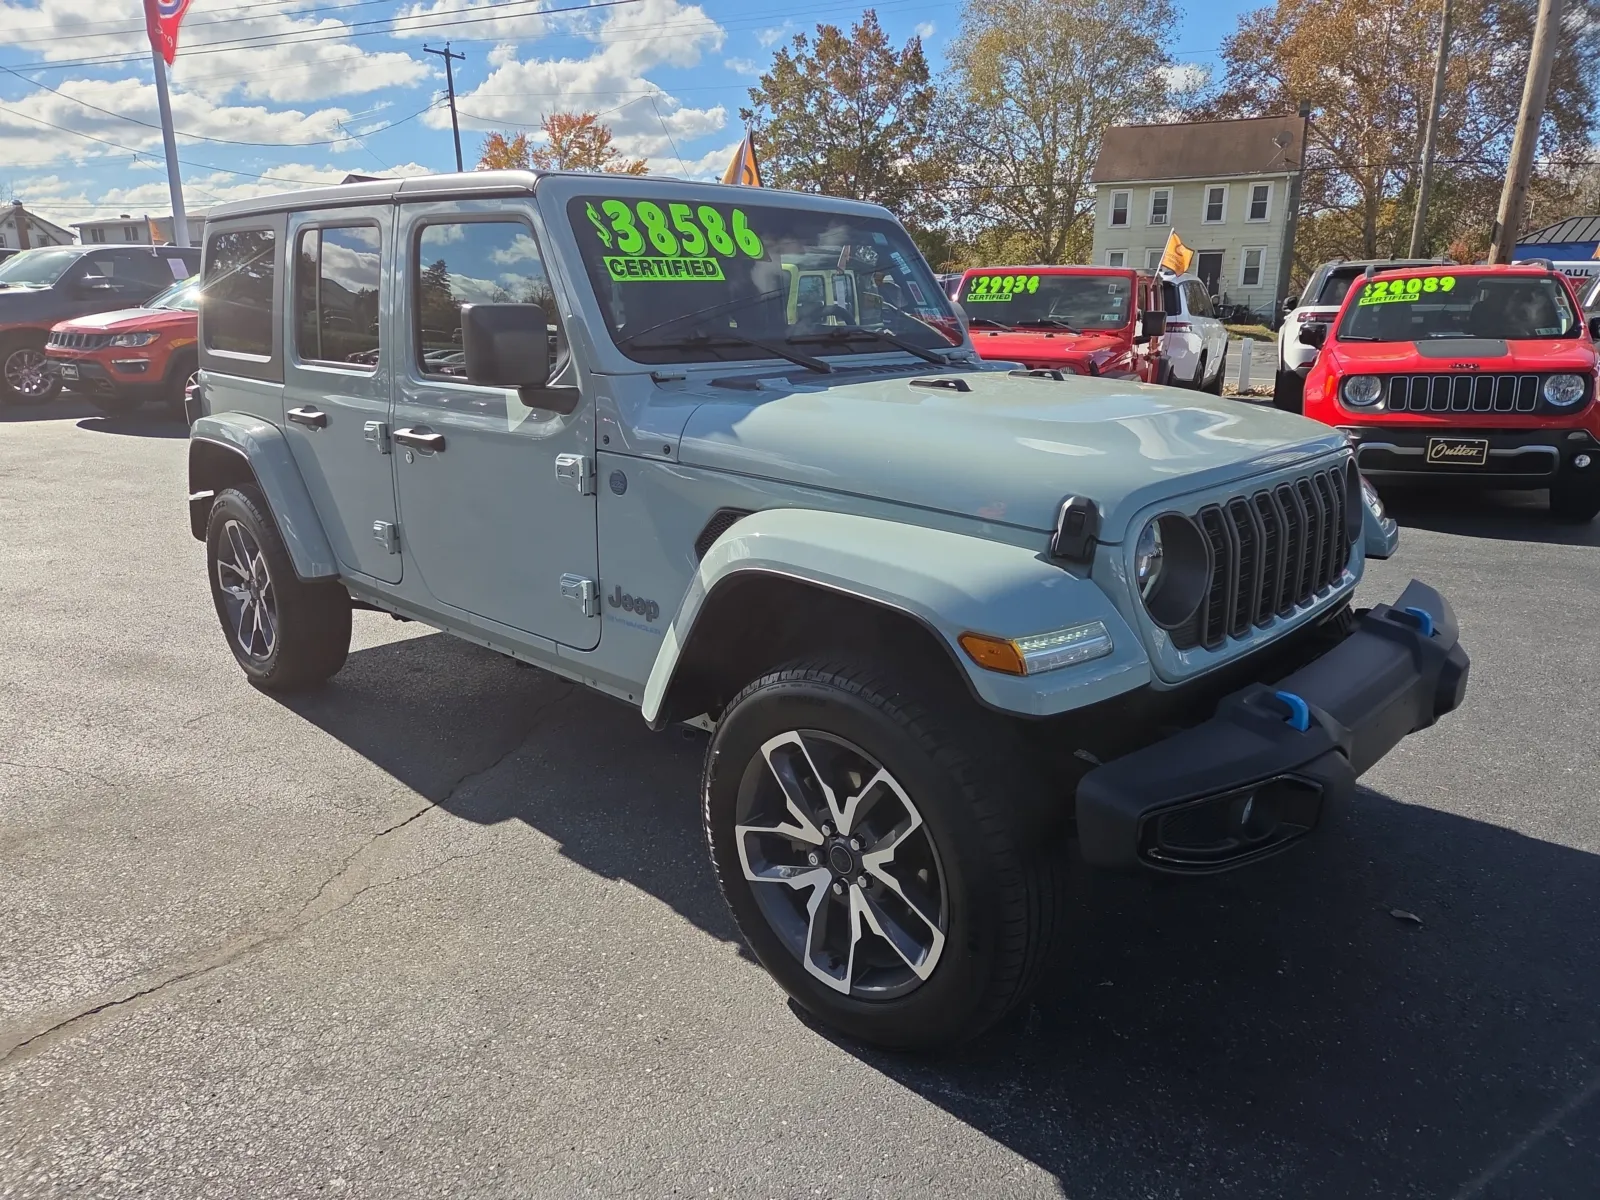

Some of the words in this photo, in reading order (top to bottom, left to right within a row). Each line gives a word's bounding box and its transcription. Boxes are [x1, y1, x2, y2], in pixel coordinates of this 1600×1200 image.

[585, 199, 764, 260] $38586
[608, 258, 719, 279] CERTIFIED
[970, 275, 1040, 294] $29934
[1363, 276, 1456, 298] $24089
[967, 293, 1011, 301] CERTIFIED
[1360, 293, 1419, 304] CERTIFIED
[1431, 442, 1482, 459] Outten
[607, 584, 660, 623] Jeep
